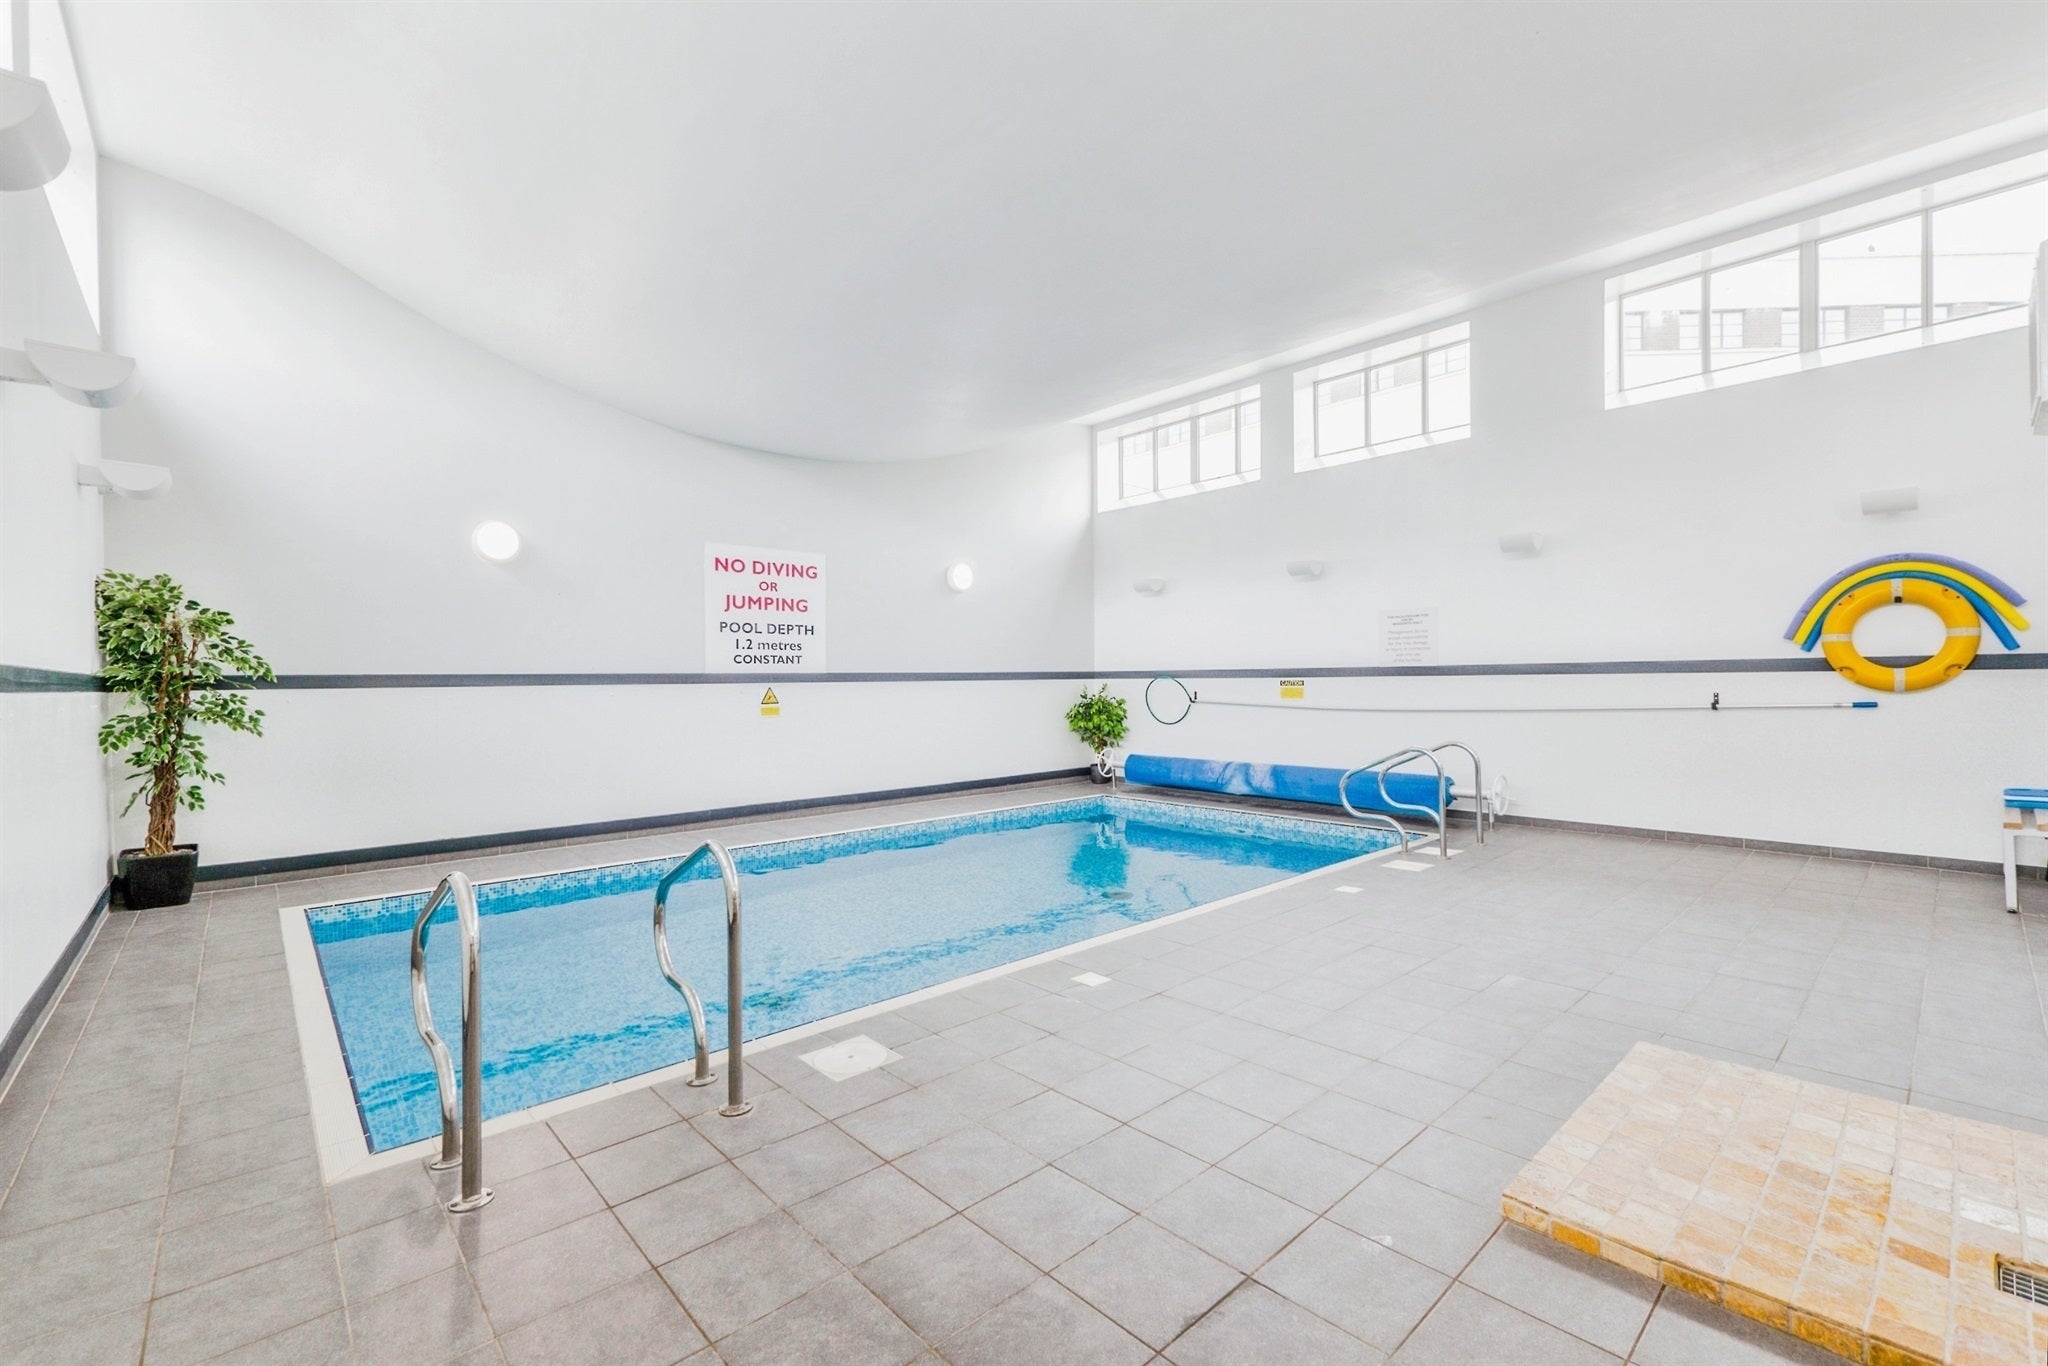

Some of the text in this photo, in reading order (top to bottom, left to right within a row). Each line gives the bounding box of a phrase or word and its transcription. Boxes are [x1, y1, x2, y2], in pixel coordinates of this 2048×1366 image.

[715, 557, 817, 579] NO DIVING
[759, 581, 778, 592] OR
[724, 595, 808, 612] JUMPING
[720, 621, 814, 635] POOL DEPTH
[735, 638, 802, 651] 1.2 metres
[733, 654, 803, 665] CONSTANT
